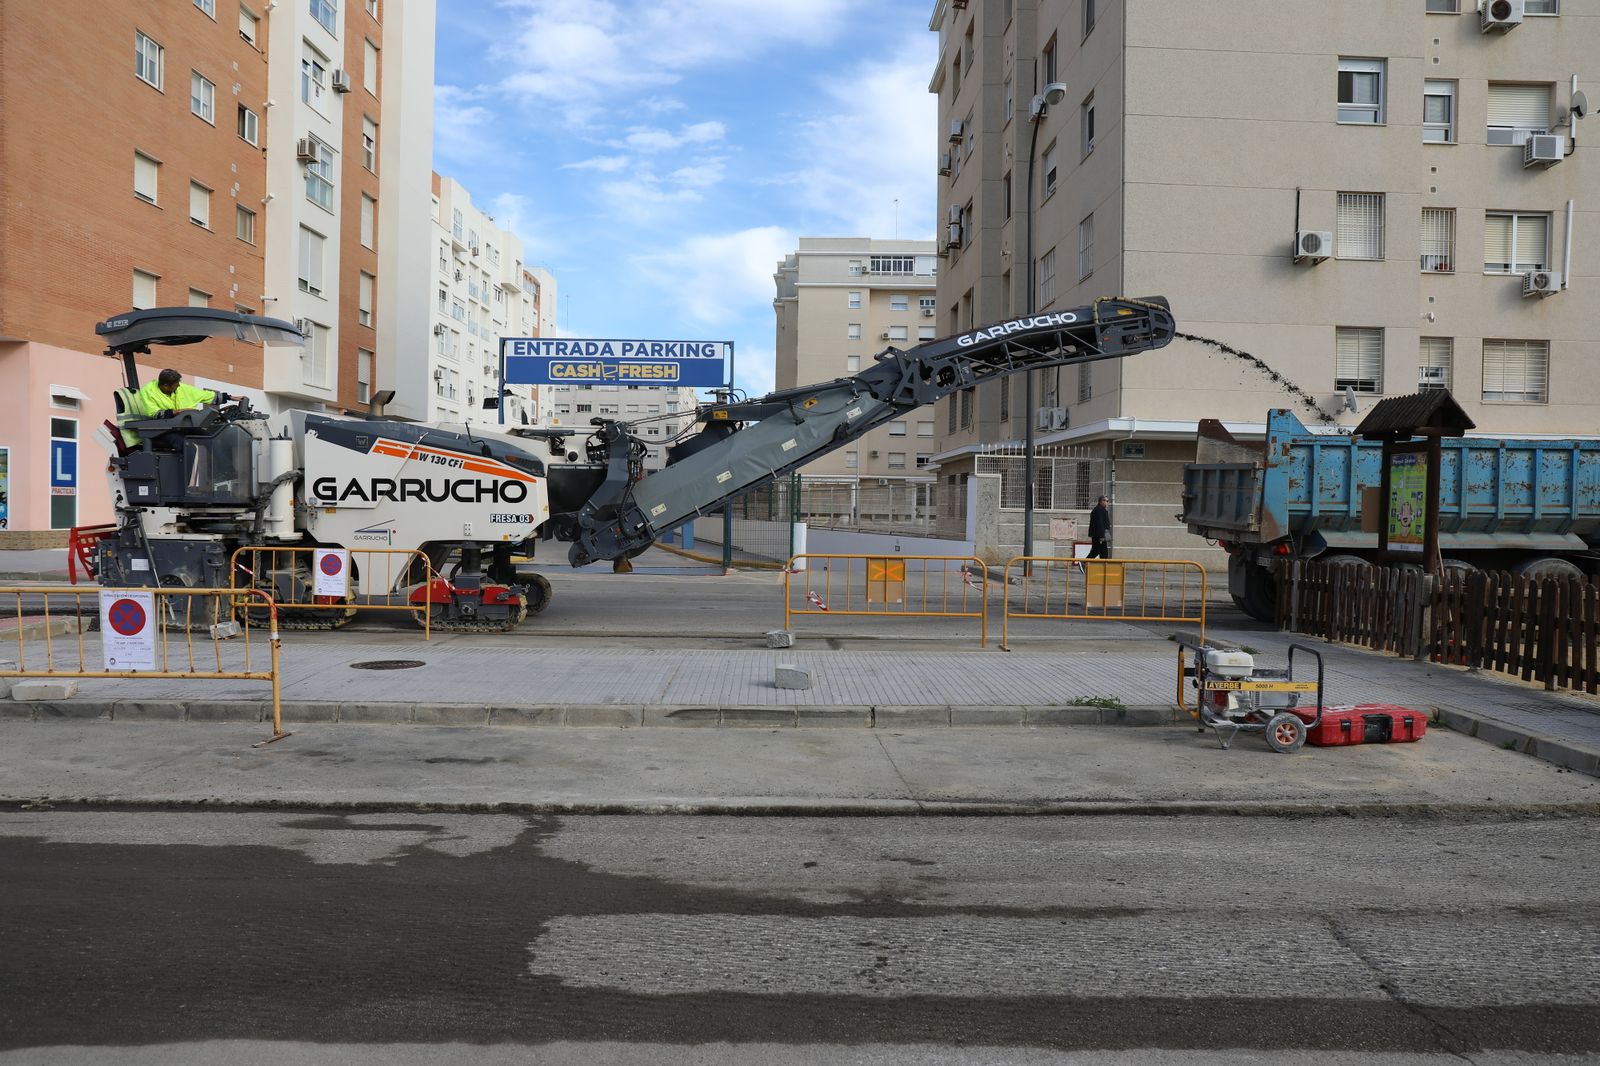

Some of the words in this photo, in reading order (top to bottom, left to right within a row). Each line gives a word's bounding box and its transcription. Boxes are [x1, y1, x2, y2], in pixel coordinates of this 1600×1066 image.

[957, 312, 1077, 347] GARRUCHO
[513, 341, 615, 357] ENTRADA
[622, 343, 715, 358] PARKING
[552, 364, 600, 378] CASH
[619, 365, 676, 378] FRESH
[57, 447, 72, 481] L
[418, 452, 429, 462] W
[430, 455, 446, 466] 130
[312, 476, 528, 504] GARRUCHO
[490, 514, 517, 523] FRESA
[518, 514, 530, 523] 03
